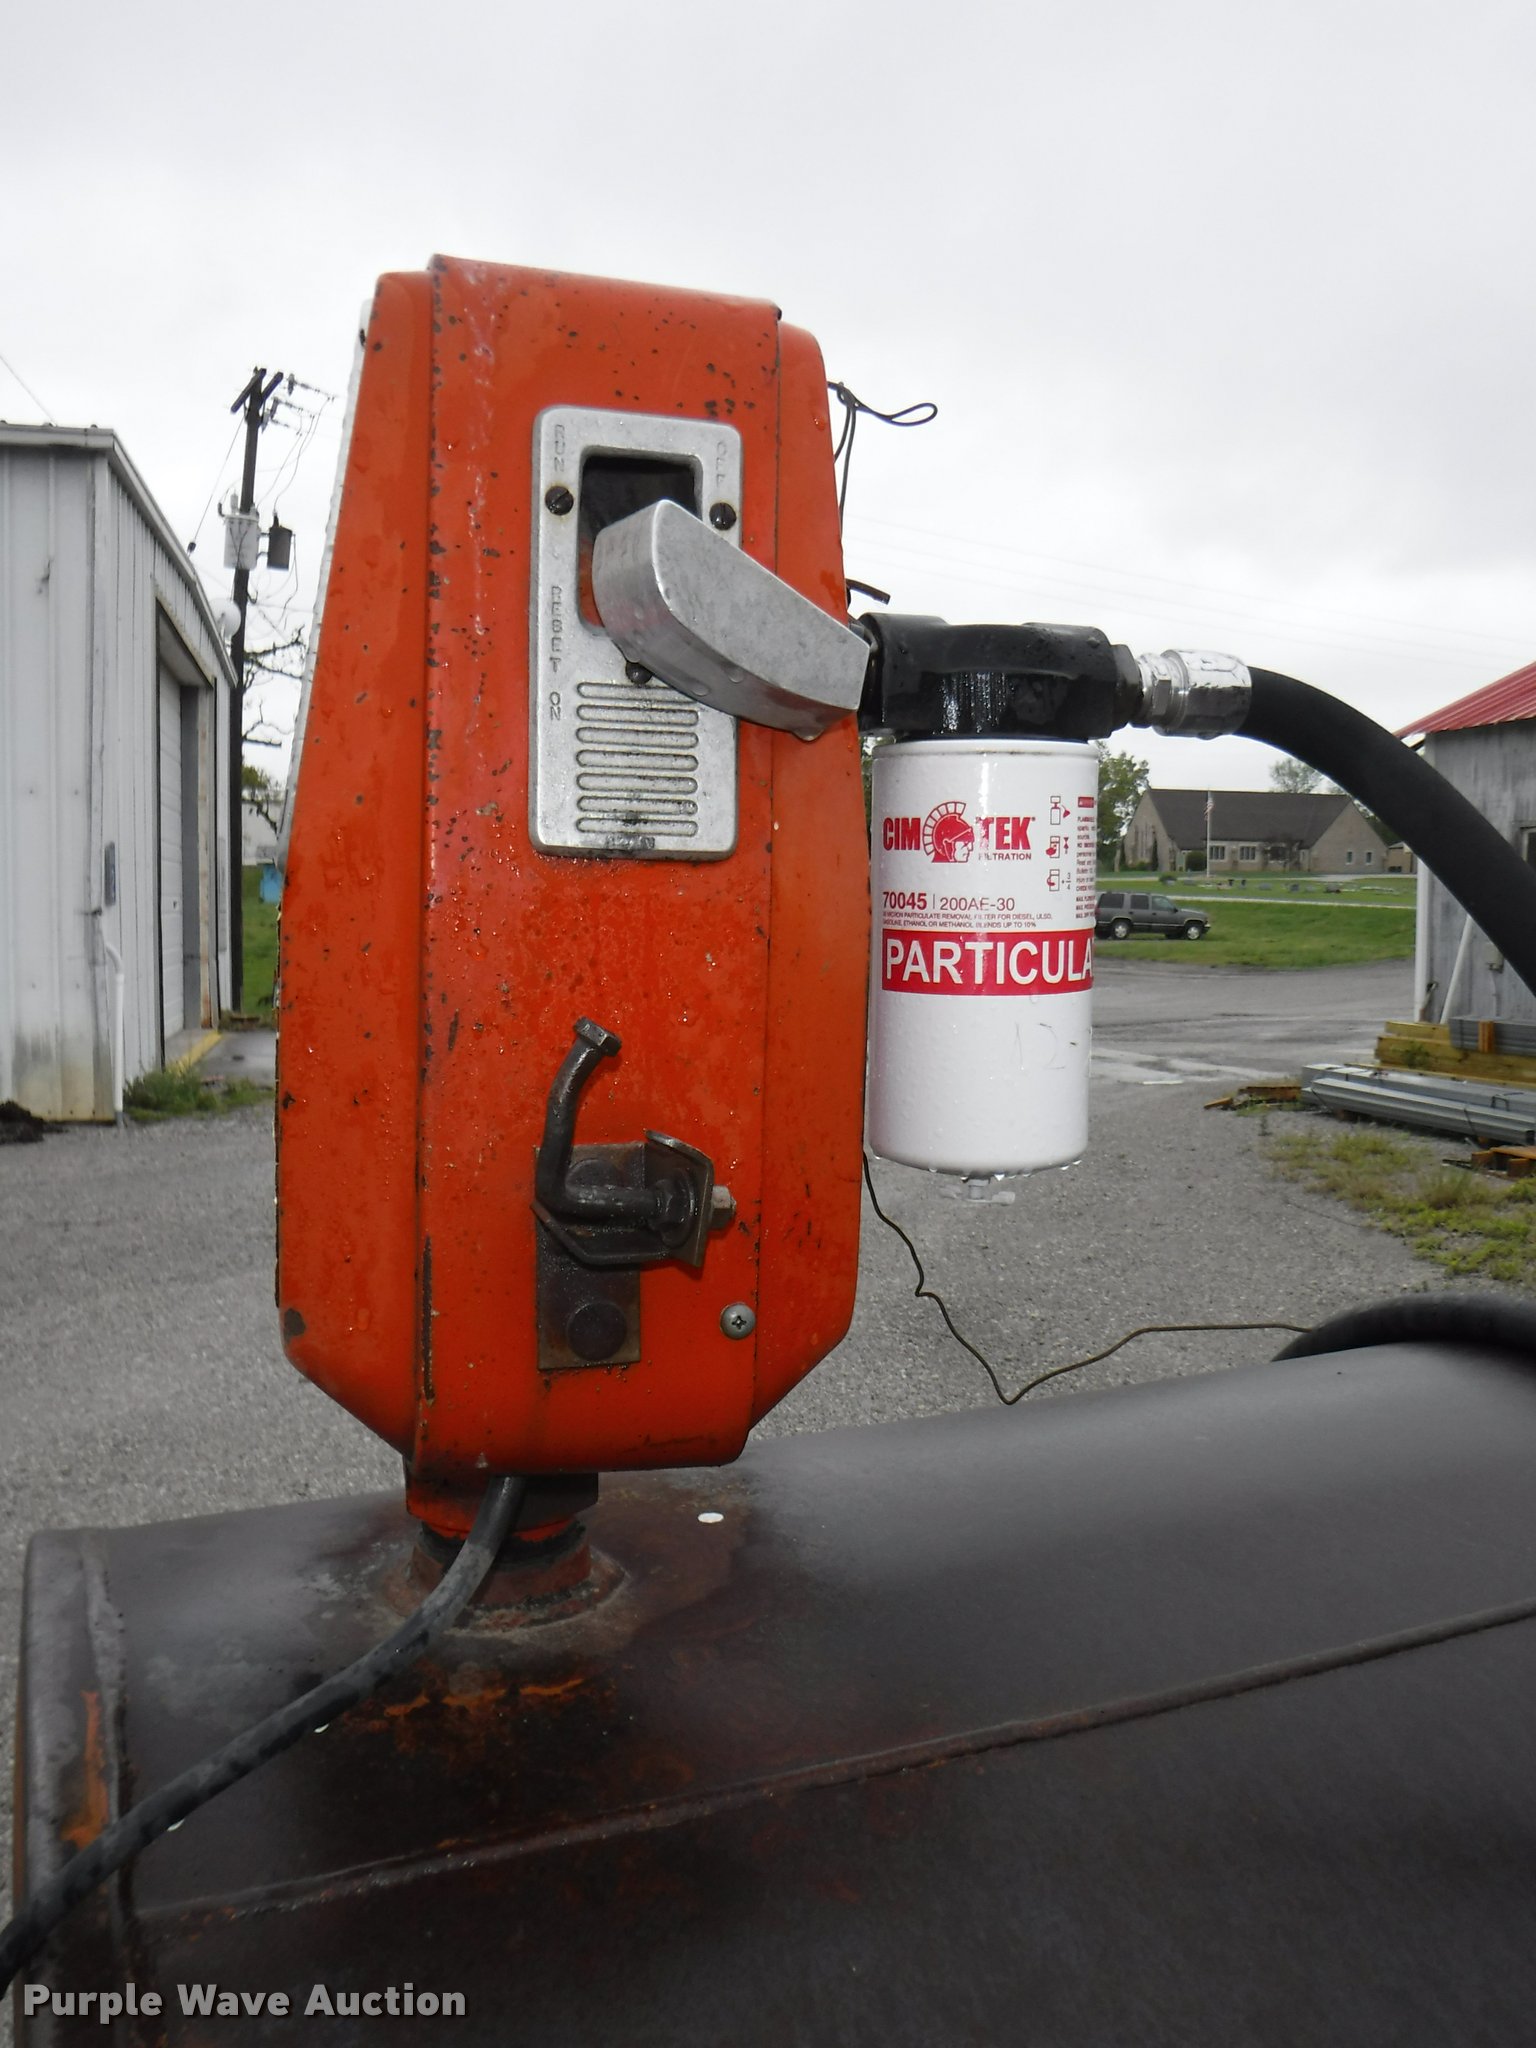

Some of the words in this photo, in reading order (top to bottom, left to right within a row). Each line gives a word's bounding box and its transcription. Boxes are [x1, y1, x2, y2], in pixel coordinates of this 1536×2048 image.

[549, 691, 561, 721] ON
[882, 816, 921, 851] CIM
[975, 816, 1032, 851] TEK
[978, 853, 1032, 861] FILTRATION
[882, 891, 928, 911] 70045
[886, 937, 1094, 985] PARTICULA
